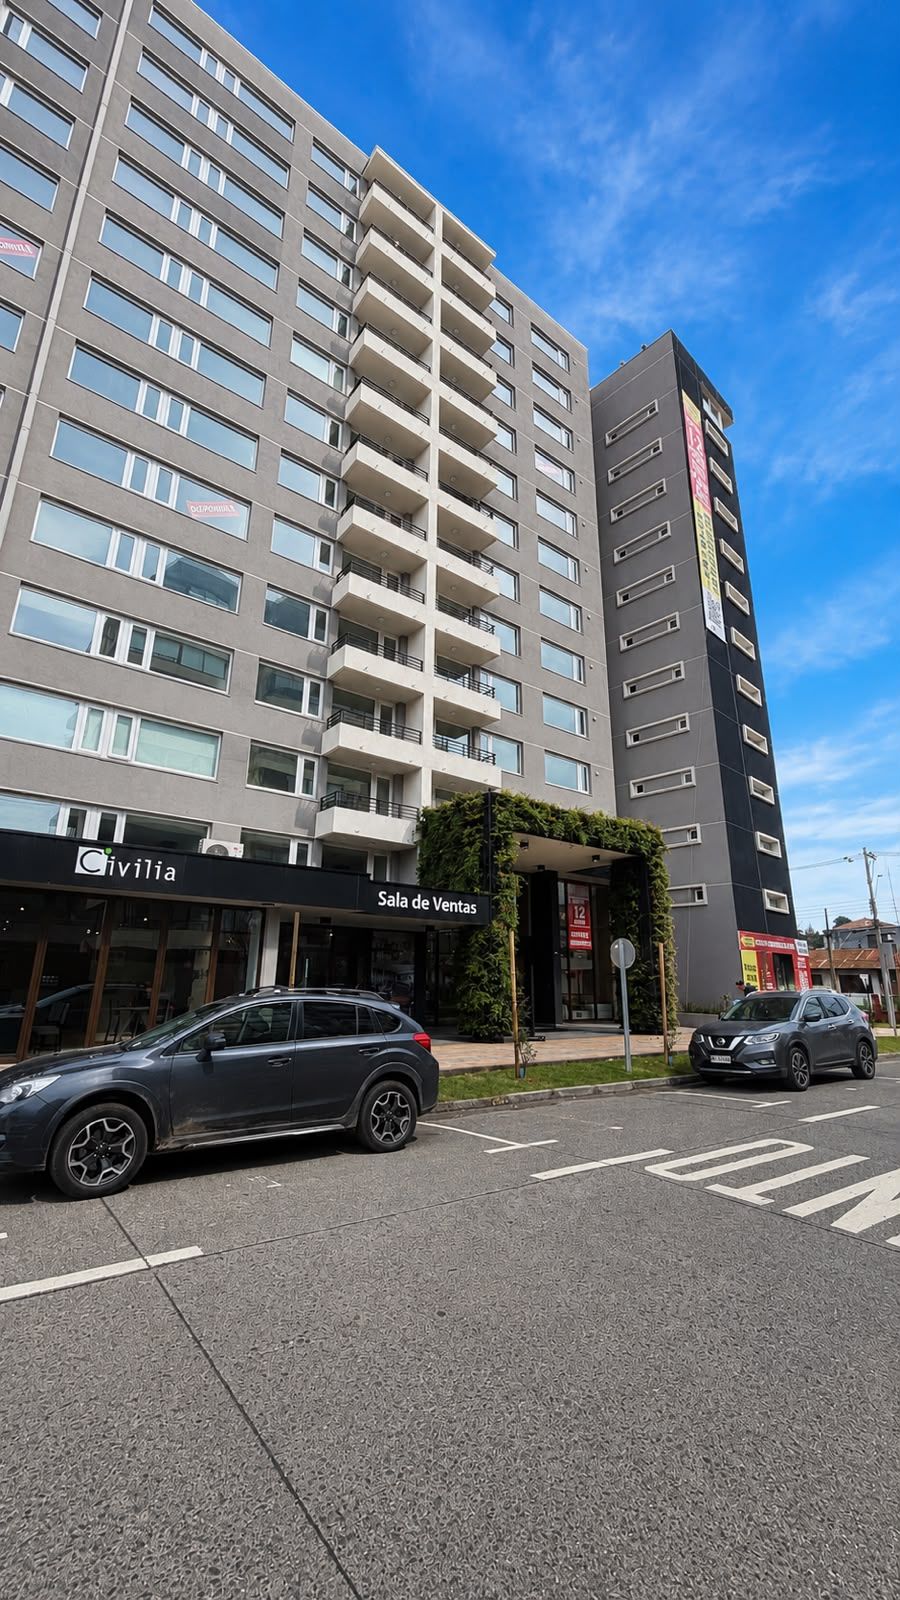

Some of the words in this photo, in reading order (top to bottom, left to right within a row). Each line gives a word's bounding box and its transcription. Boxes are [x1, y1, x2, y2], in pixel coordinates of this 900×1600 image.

[79, 847, 176, 881] Civilia
[378, 890, 408, 909] Sala
[411, 893, 430, 910] de
[432, 896, 477, 914] Ventas
[574, 905, 586, 919] 12
